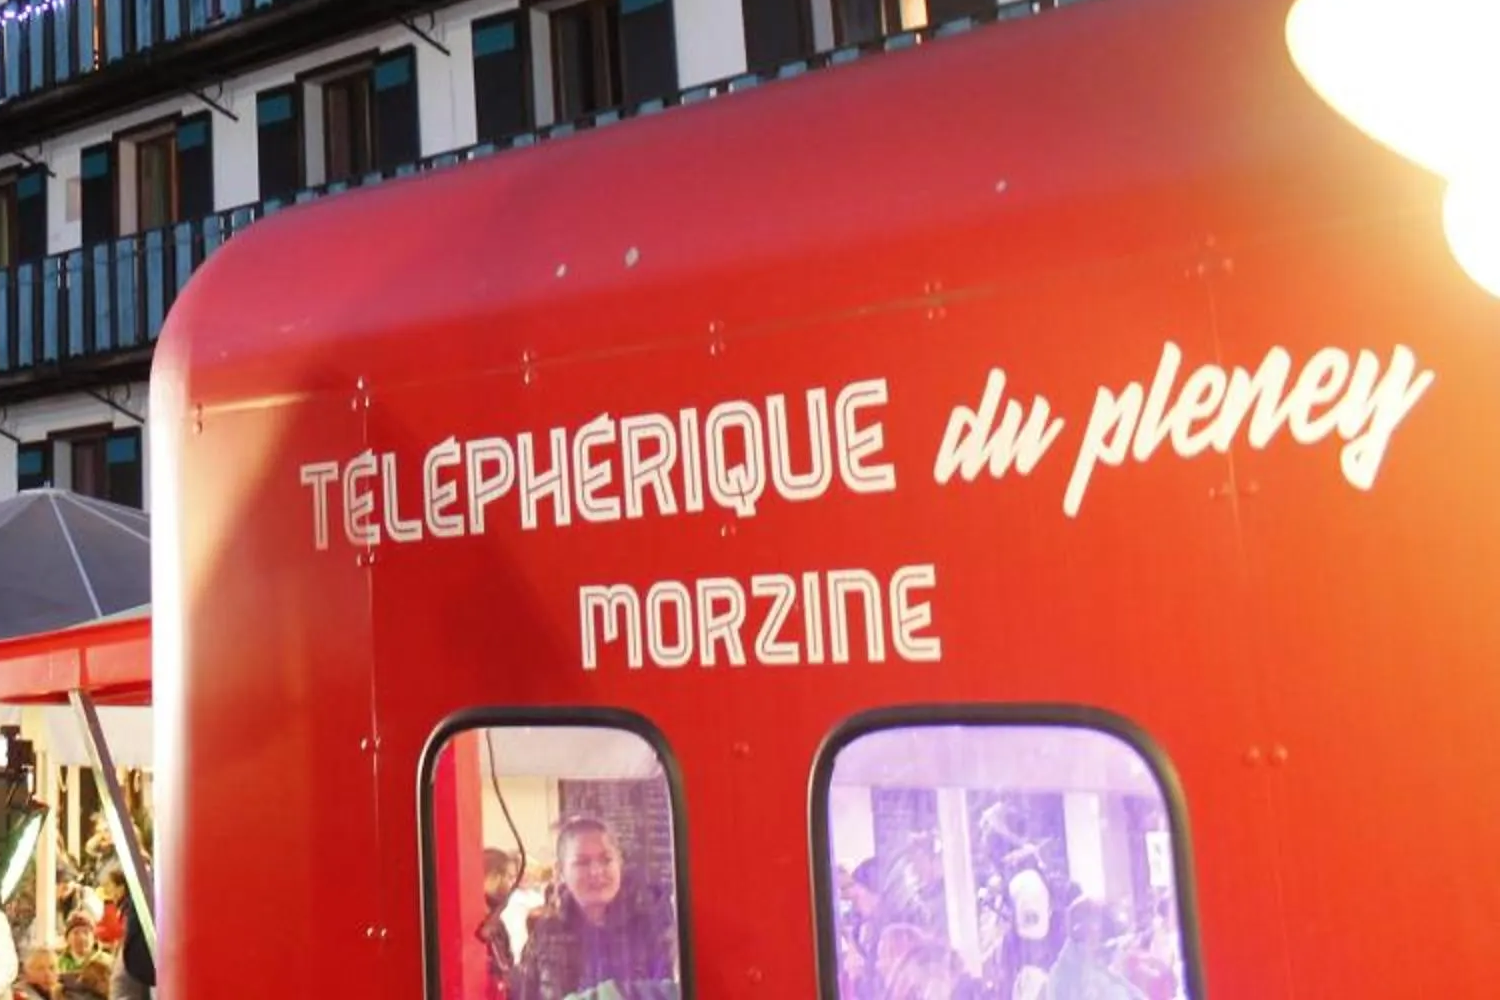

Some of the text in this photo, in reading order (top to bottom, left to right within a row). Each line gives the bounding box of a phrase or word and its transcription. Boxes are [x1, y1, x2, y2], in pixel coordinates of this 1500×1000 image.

[300, 340, 1436, 550] TÉLÉPHÉRIQUE du pleney
[579, 564, 942, 670] MORZINE
